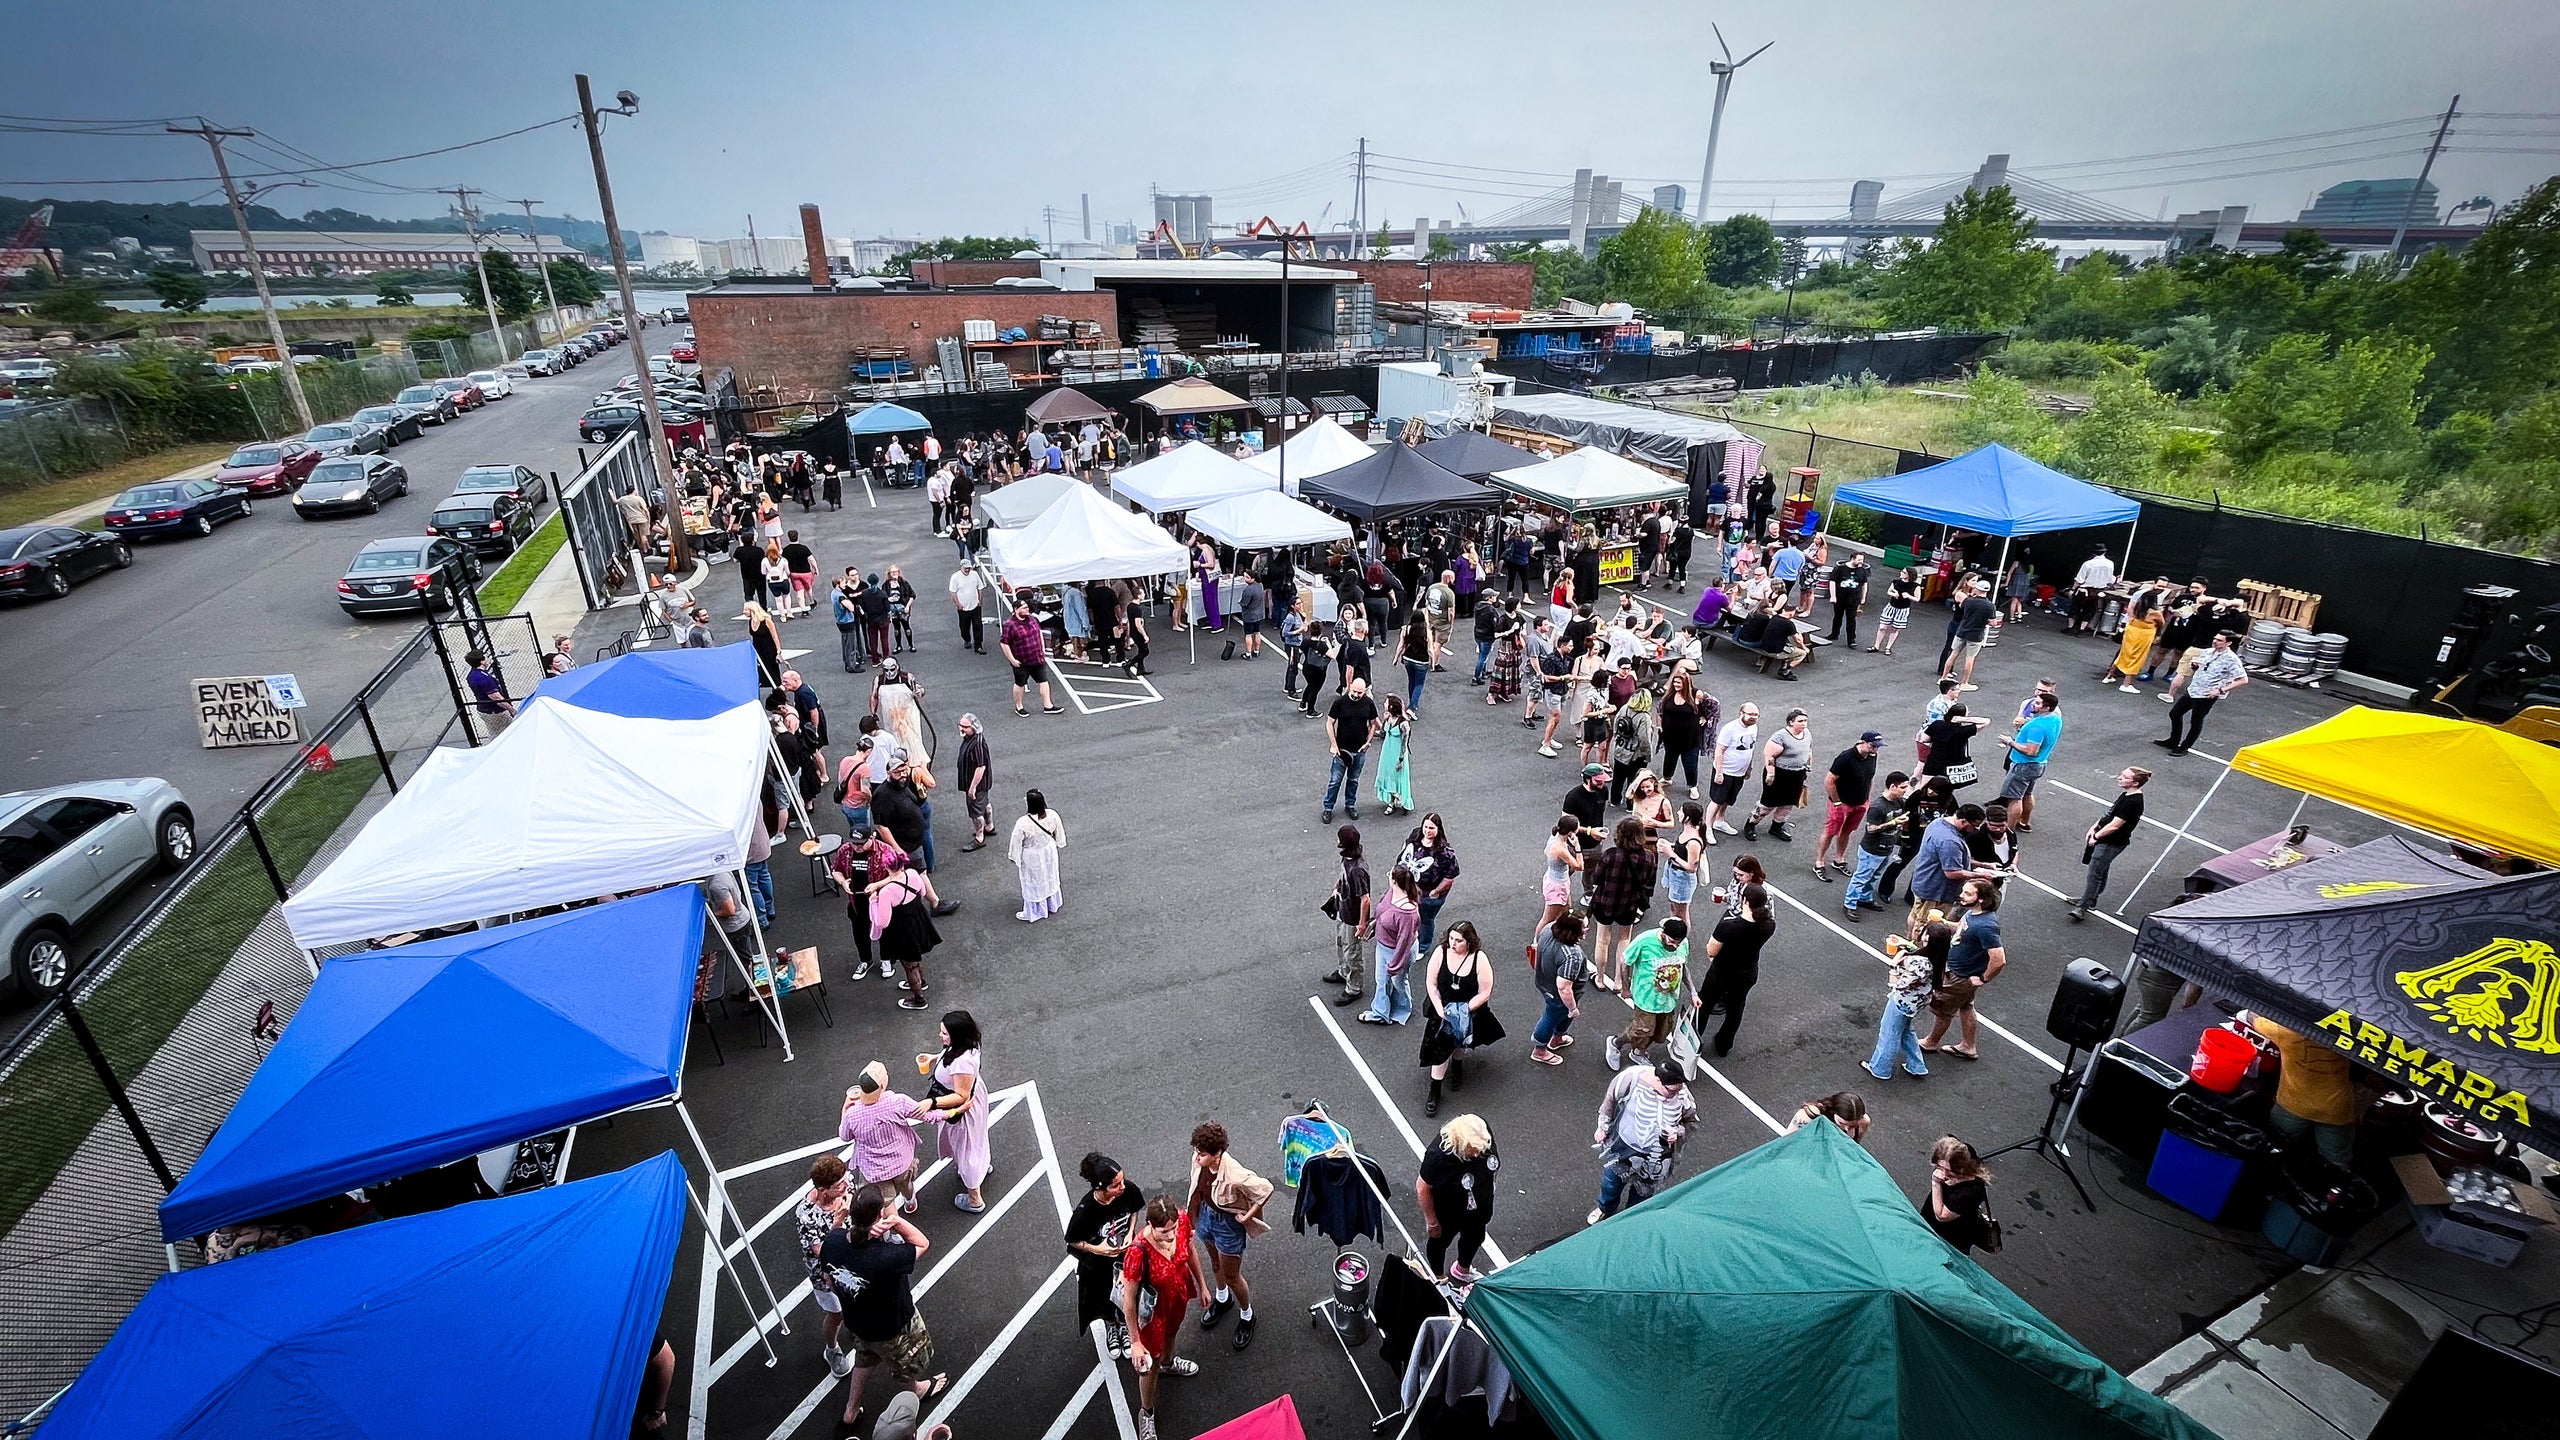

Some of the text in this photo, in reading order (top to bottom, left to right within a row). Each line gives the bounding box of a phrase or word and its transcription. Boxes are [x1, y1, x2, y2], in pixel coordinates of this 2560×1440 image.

[201, 699, 291, 723] PARKING
[225, 720, 291, 743] AHEAD
[2314, 1008, 2532, 1127] ARMADA
[2334, 1034, 2501, 1122] BREWING
